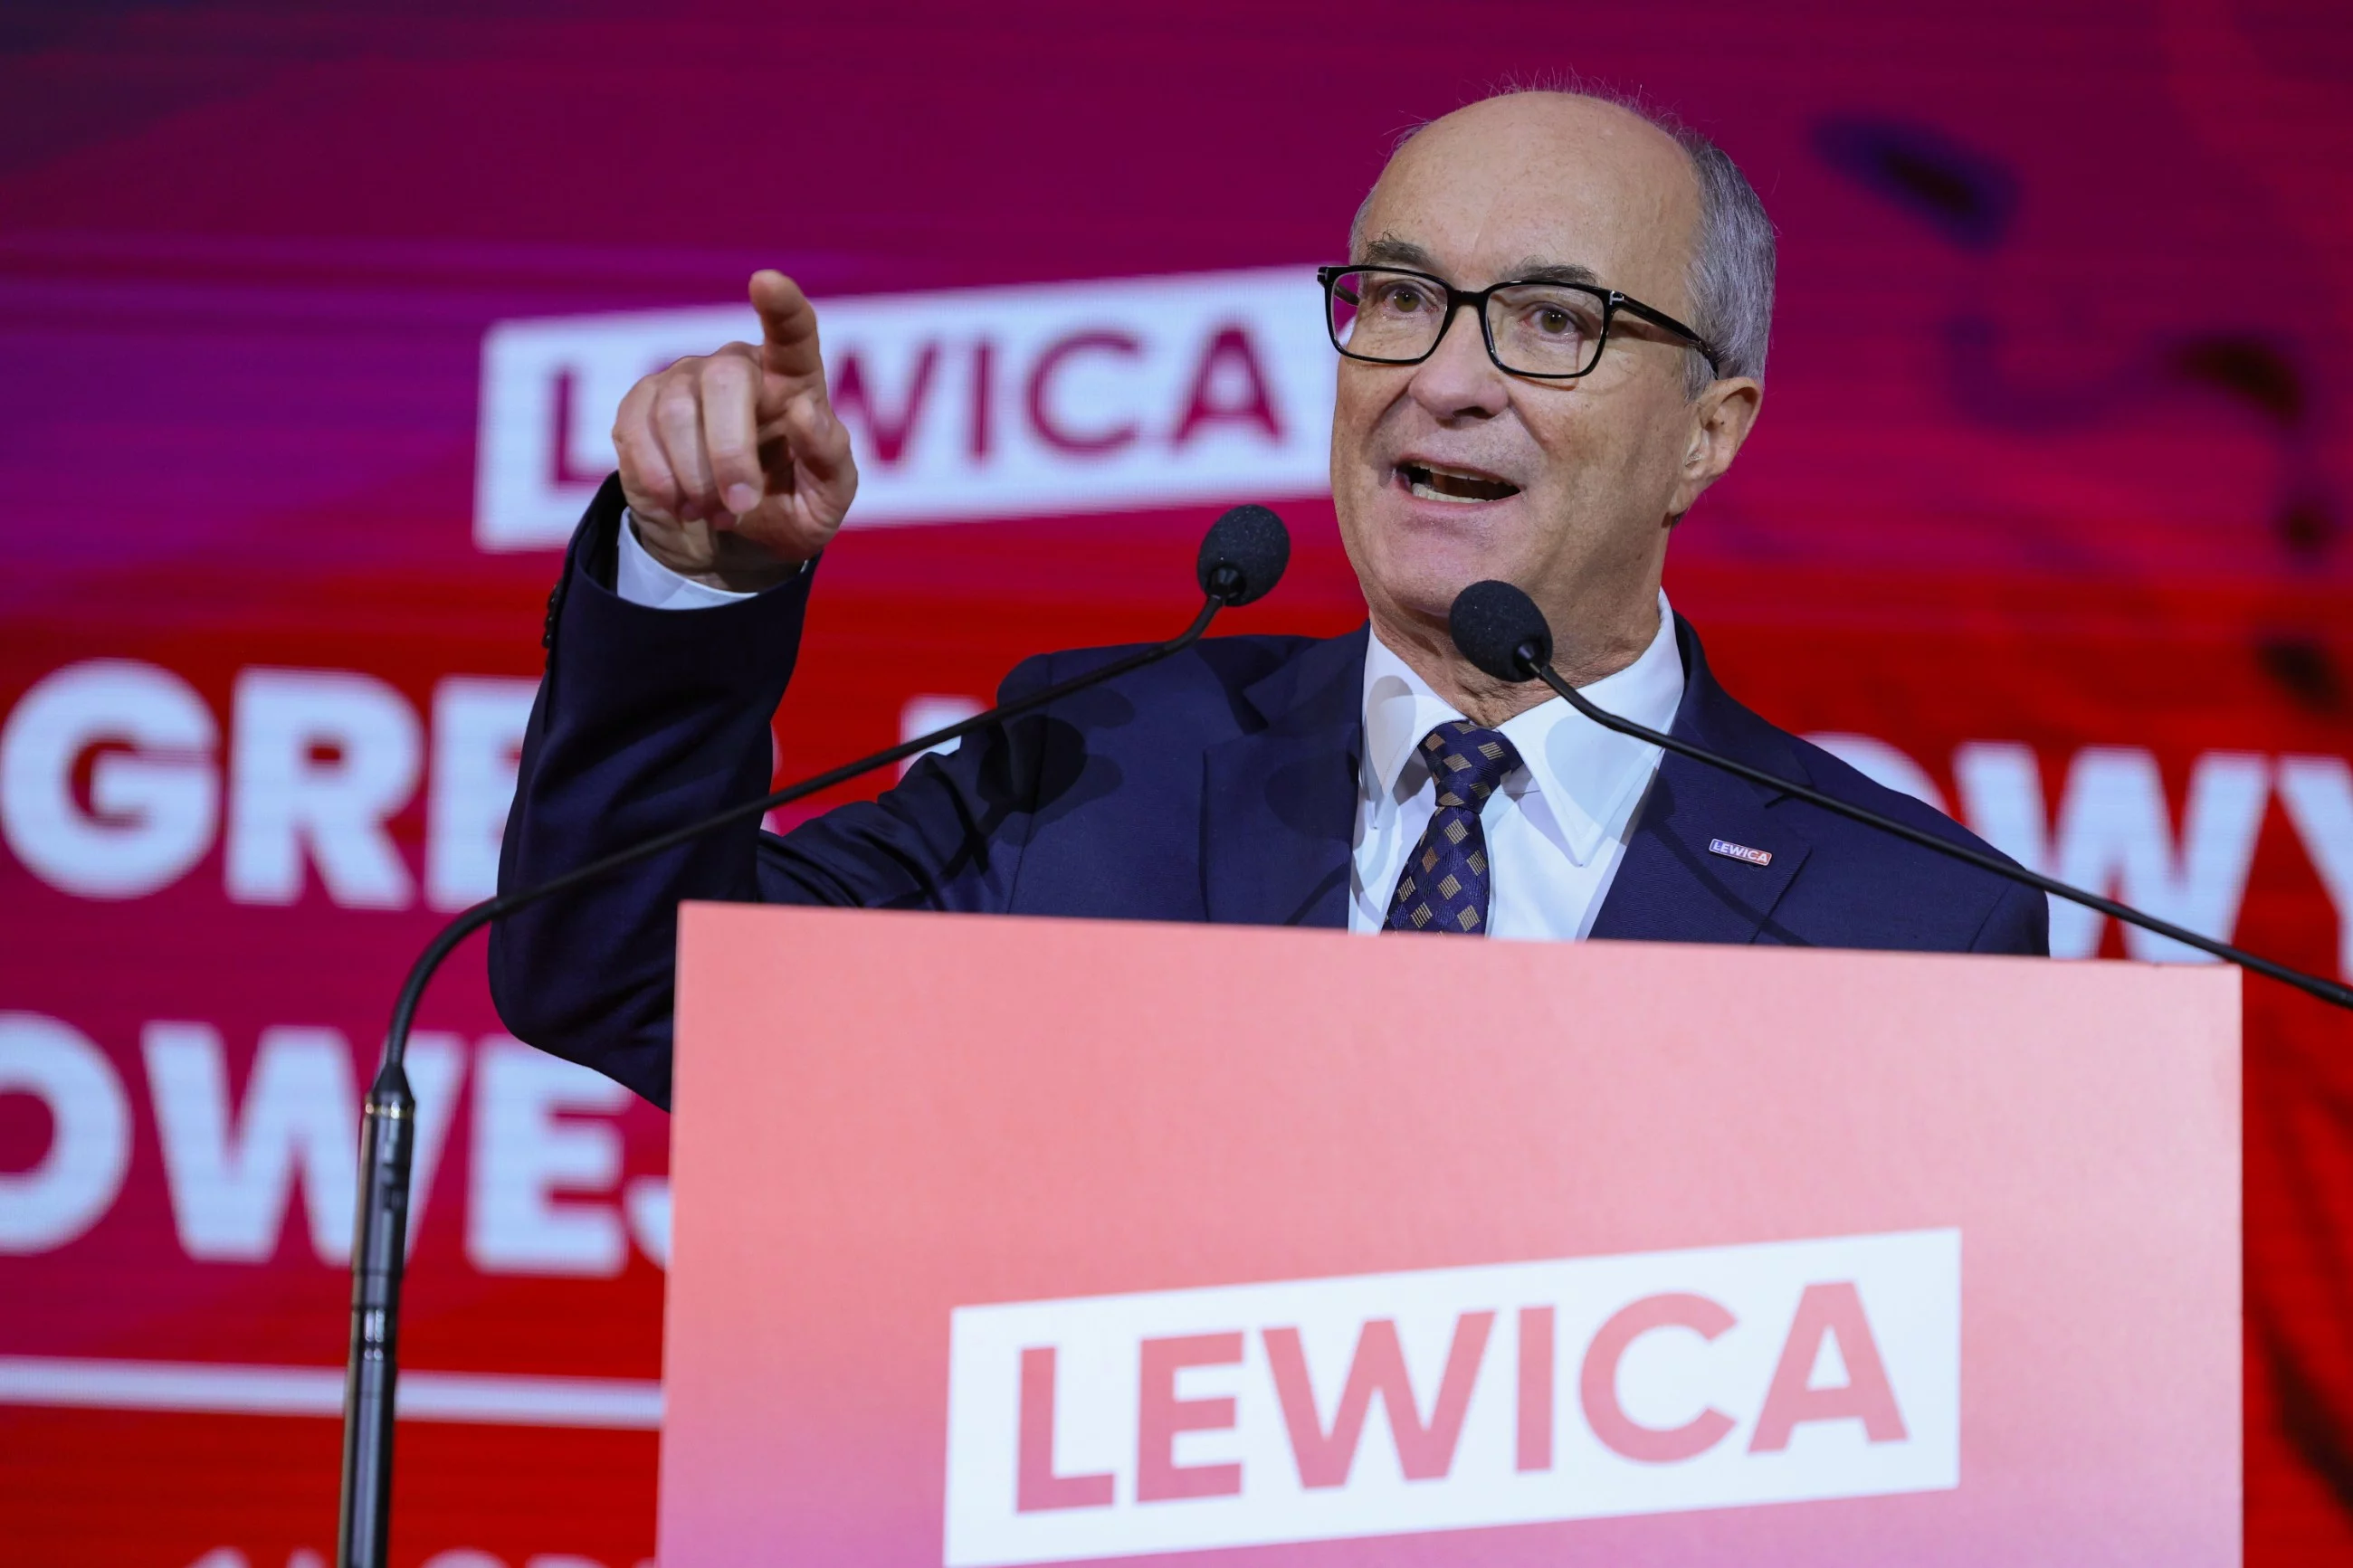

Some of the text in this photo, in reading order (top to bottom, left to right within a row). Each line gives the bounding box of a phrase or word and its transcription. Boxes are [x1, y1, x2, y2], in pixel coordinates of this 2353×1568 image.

[549, 321, 1291, 494] LWICA
[0, 656, 784, 914] GRE
[1712, 841, 1768, 863] LEWICA
[0, 1009, 672, 1279] OWE
[1015, 1280, 1910, 1515] LEWICA
